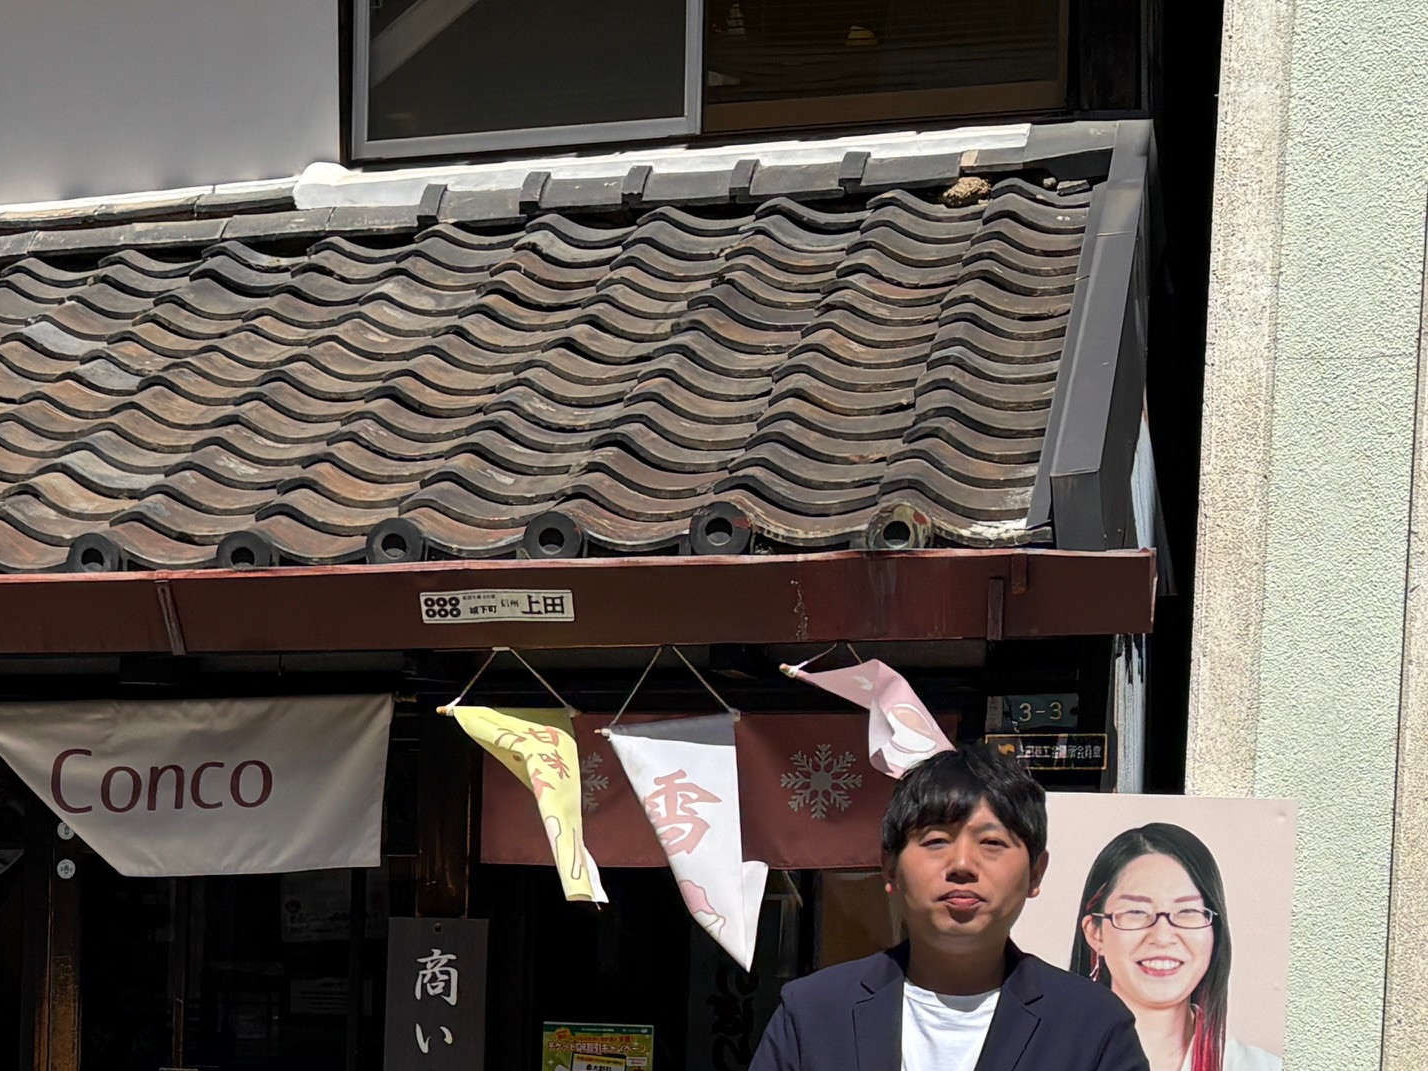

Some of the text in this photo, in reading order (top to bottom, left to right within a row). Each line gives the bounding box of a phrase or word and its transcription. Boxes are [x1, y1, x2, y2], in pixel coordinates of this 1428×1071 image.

[521, 594, 565, 615] 上田
[1018, 701, 1063, 722] 3-3
[51, 748, 274, 814] Conco
